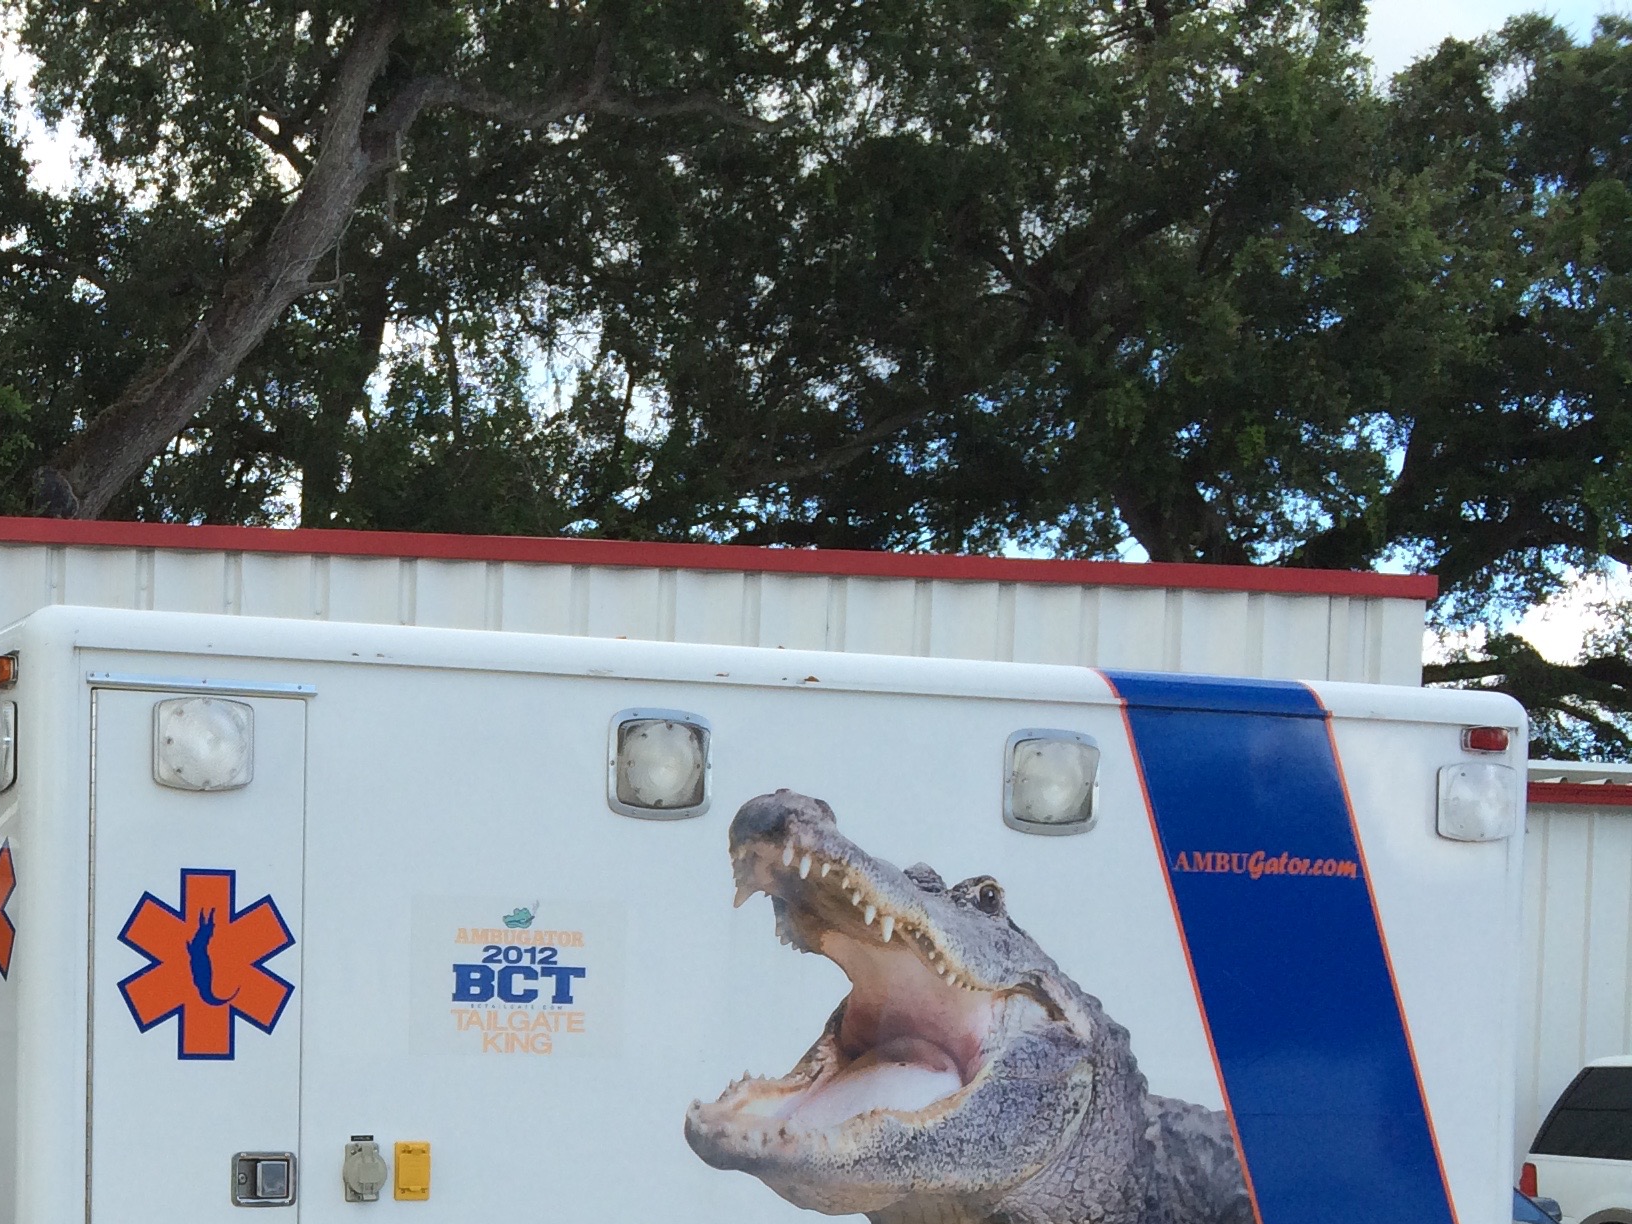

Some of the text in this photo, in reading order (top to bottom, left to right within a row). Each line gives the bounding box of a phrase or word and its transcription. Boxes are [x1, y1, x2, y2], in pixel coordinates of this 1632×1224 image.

[1173, 850, 1358, 880] AMBUGator.com
[454, 927, 585, 948] AMBUGATOR
[481, 944, 559, 966] 2012
[451, 963, 587, 1005] BCT
[450, 1008, 586, 1034] TAILGATE
[481, 1032, 554, 1056] KING
